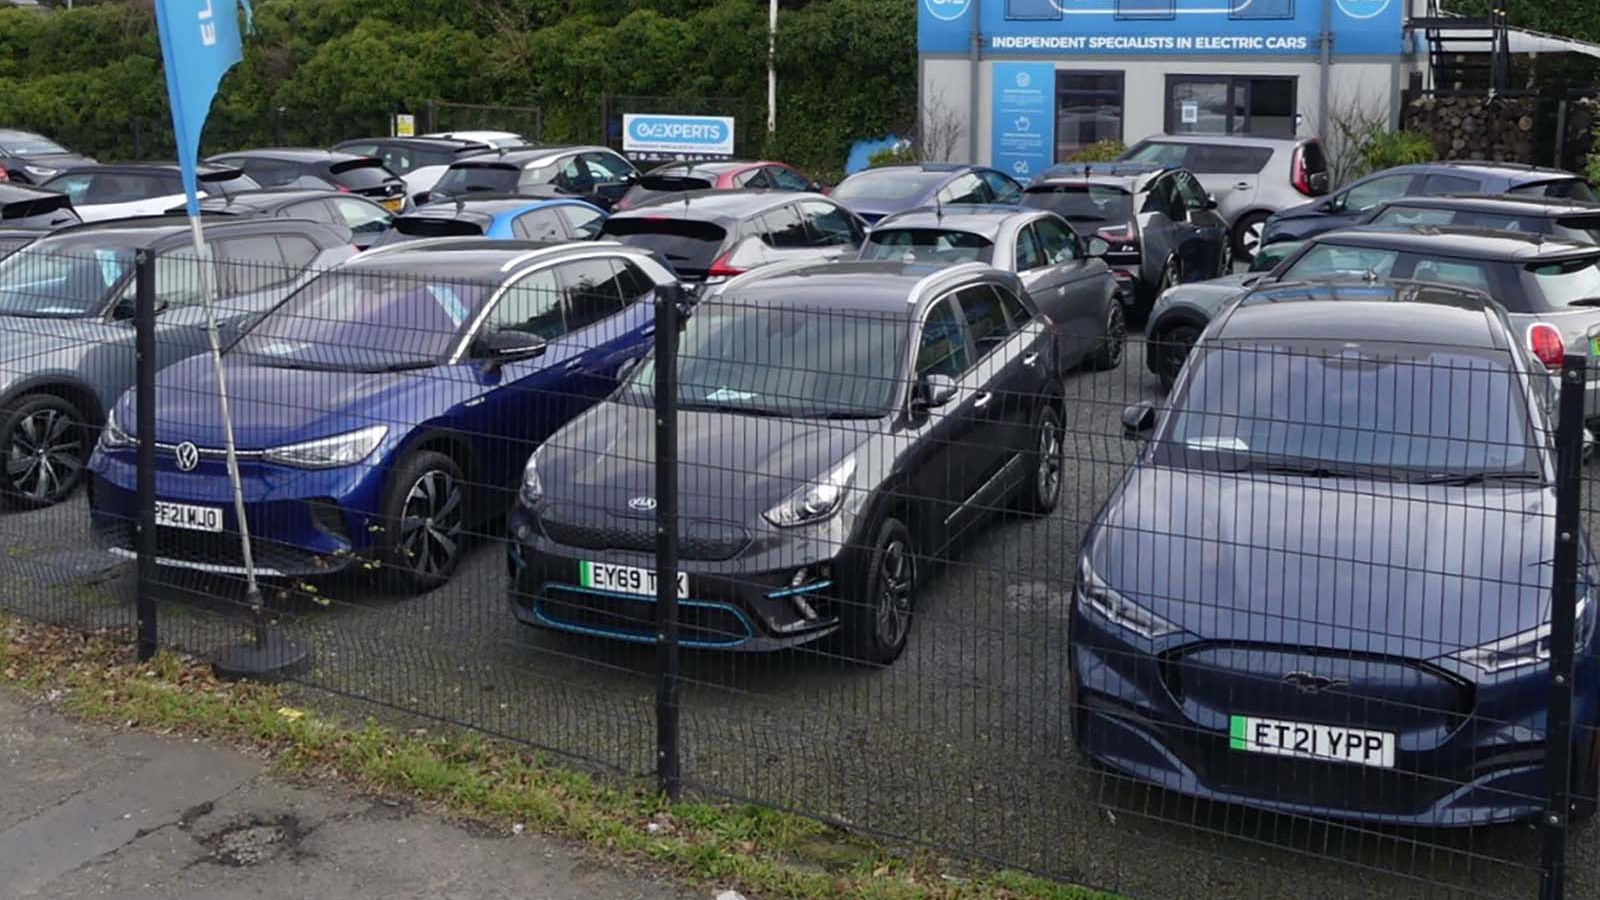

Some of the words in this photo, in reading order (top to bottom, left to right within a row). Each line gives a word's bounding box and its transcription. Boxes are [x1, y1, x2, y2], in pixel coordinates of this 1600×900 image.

[992, 36, 1087, 49] INDEPENDENT
[1089, 36, 1174, 49] SPECIALISTS
[1176, 36, 1191, 49] IN
[1195, 36, 1263, 49] ELECTRIC
[1266, 36, 1307, 49] CARS
[593, 566, 640, 589] EY69
[1255, 723, 1317, 753] ET21
[1328, 731, 1384, 760] YPP
